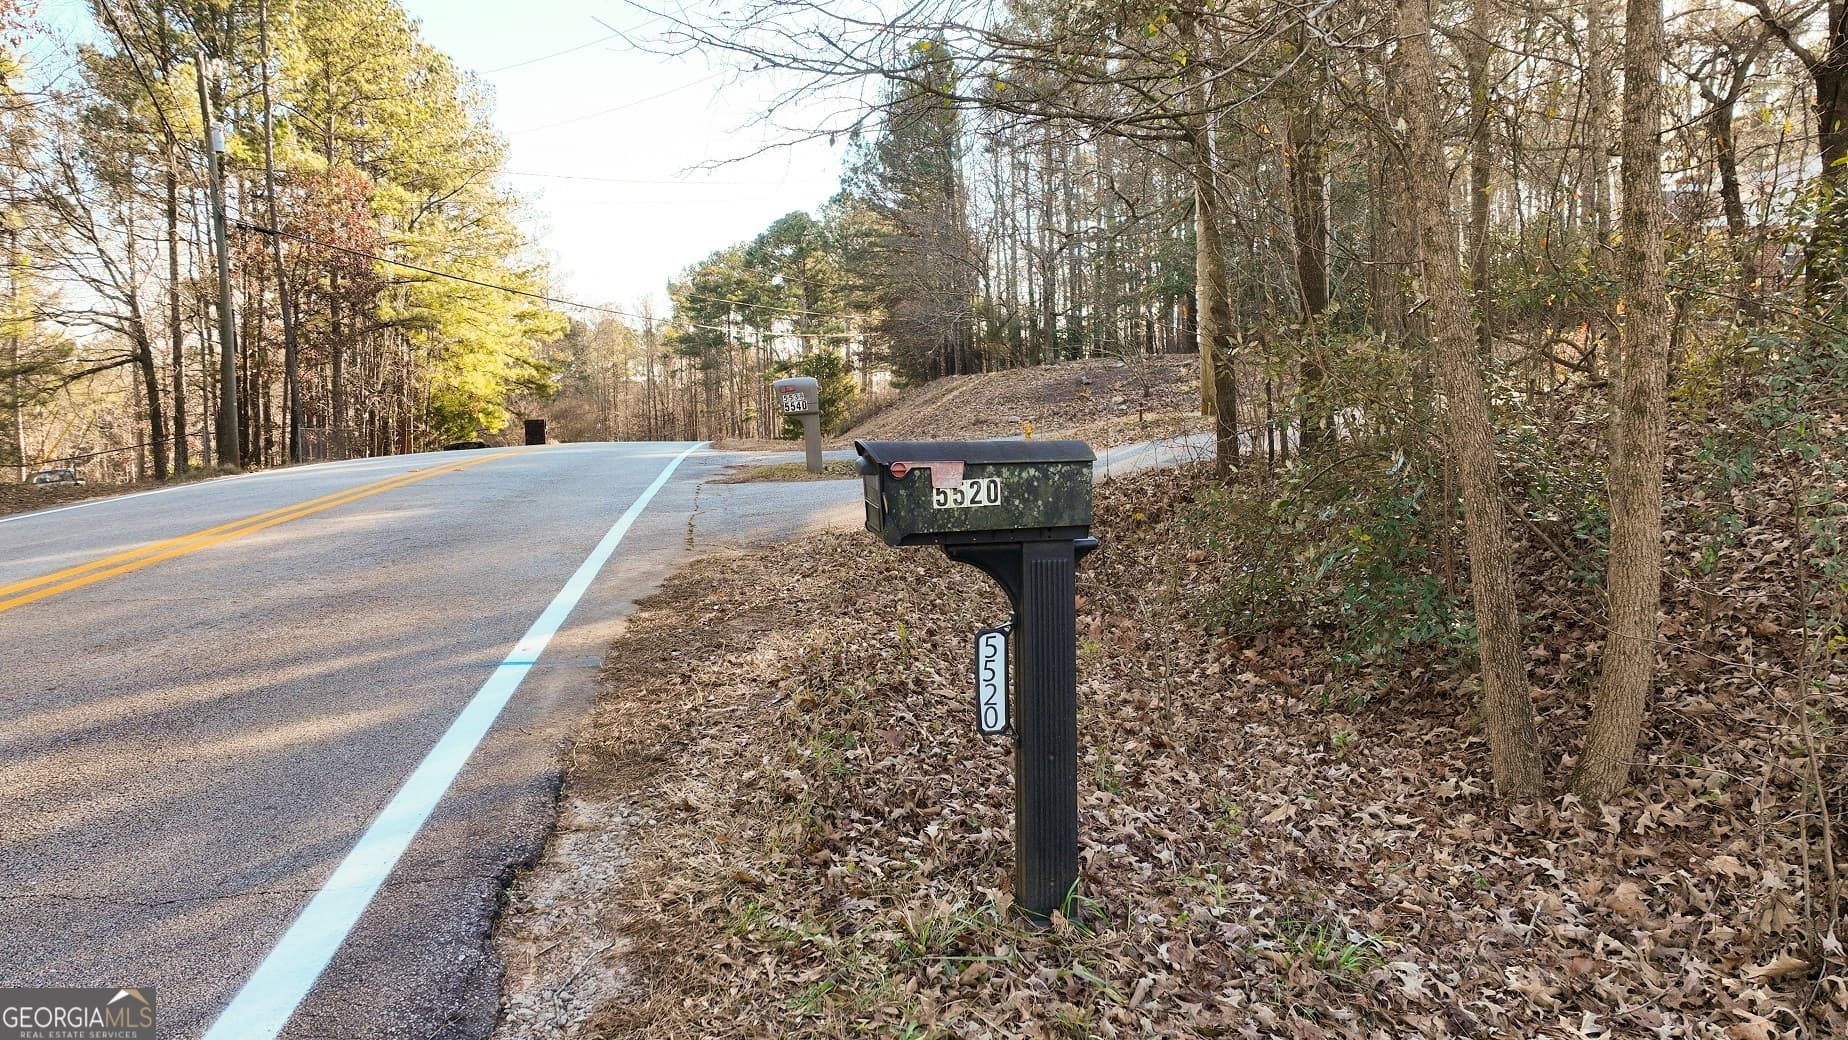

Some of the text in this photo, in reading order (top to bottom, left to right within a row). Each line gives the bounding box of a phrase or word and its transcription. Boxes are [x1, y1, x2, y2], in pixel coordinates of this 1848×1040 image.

[784, 401, 807, 412] 5540
[935, 479, 999, 507] 5520
[982, 635, 998, 729] 5520
